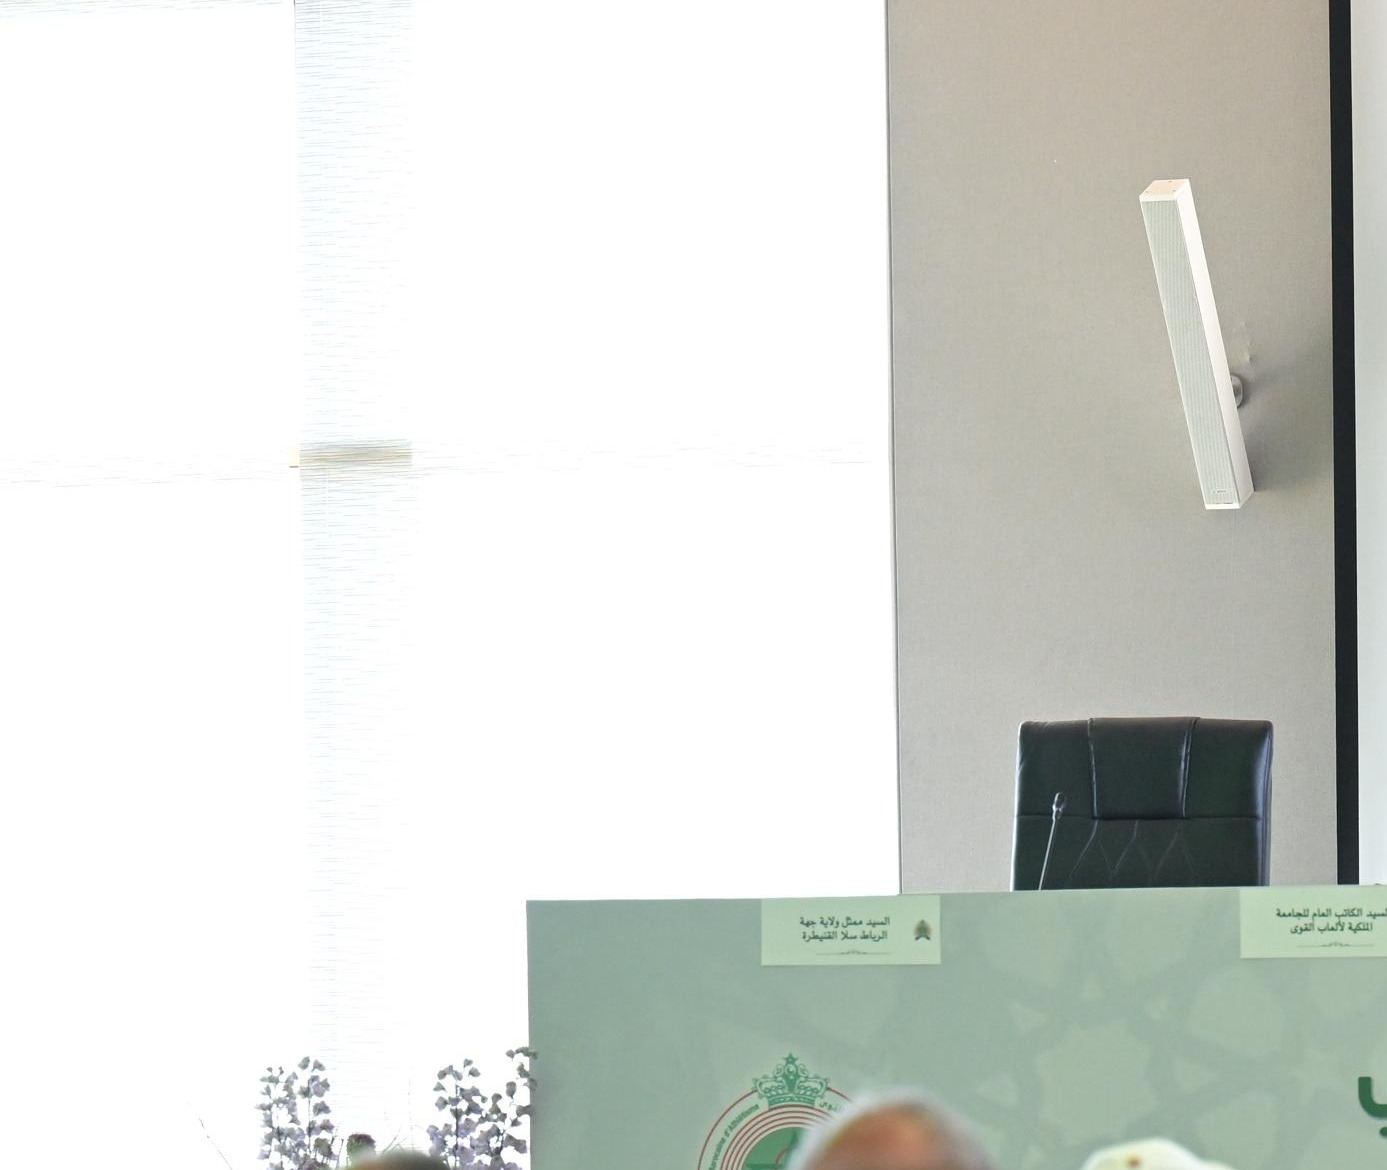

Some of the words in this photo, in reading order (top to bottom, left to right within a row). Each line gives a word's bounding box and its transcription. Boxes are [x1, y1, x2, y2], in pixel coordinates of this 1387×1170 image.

[1276, 908, 1310, 920] للجامعة
[1312, 908, 1332, 921] العام
[1334, 908, 1363, 920] الكاتب
[799, 917, 817, 928] جهة
[866, 916, 890, 928] السيد
[1348, 922, 1373, 934] الملكية
[841, 930, 857, 941] سلا
[860, 930, 888, 942] الرباط
